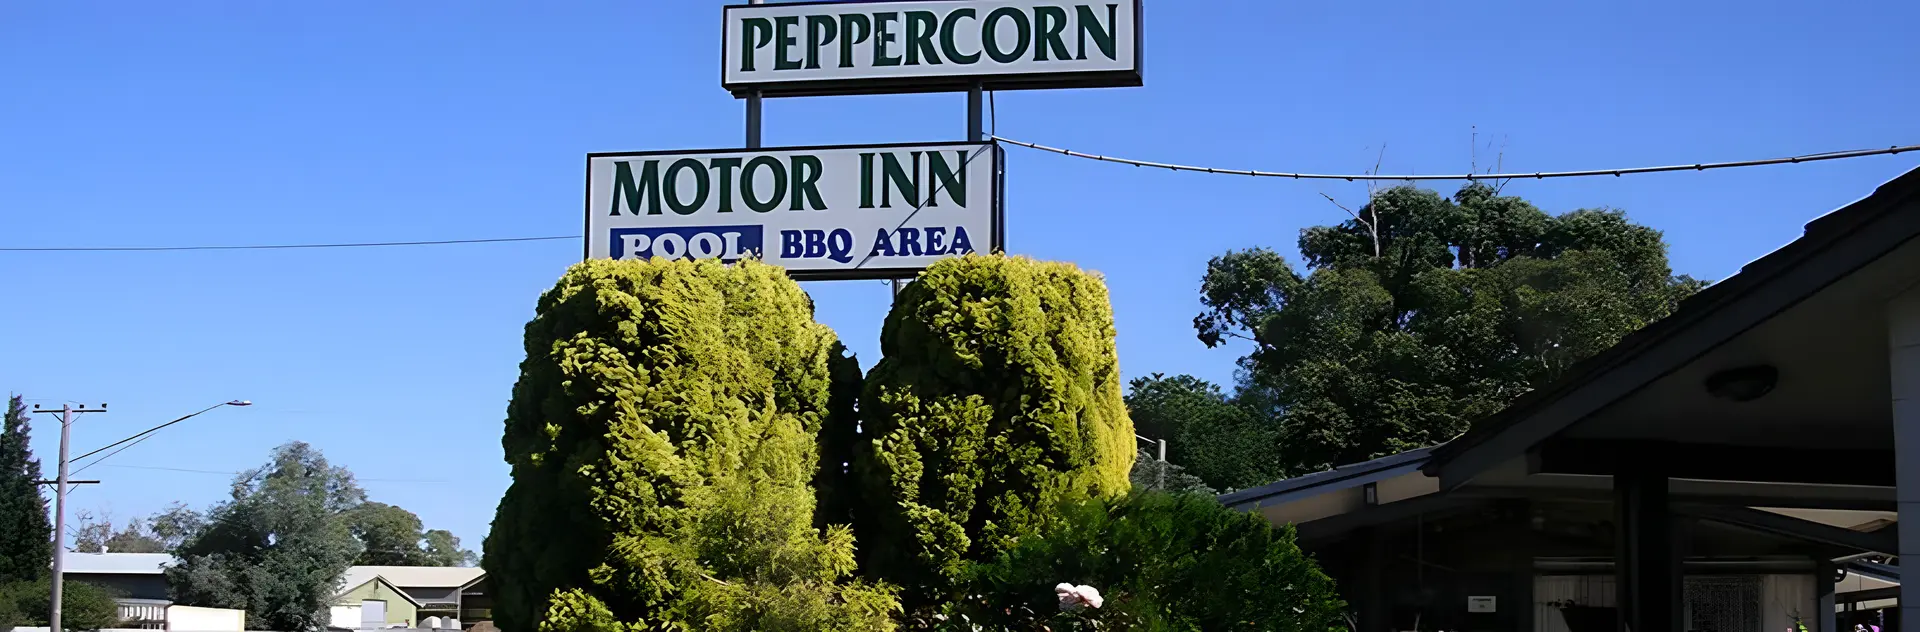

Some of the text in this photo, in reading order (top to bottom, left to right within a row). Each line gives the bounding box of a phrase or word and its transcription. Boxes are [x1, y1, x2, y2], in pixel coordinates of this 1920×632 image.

[740, 4, 1118, 72] PEPPERCORN
[609, 150, 968, 216] MOTOR INN
[620, 232, 748, 260] POOL
[779, 226, 975, 264] BBQ AREA
